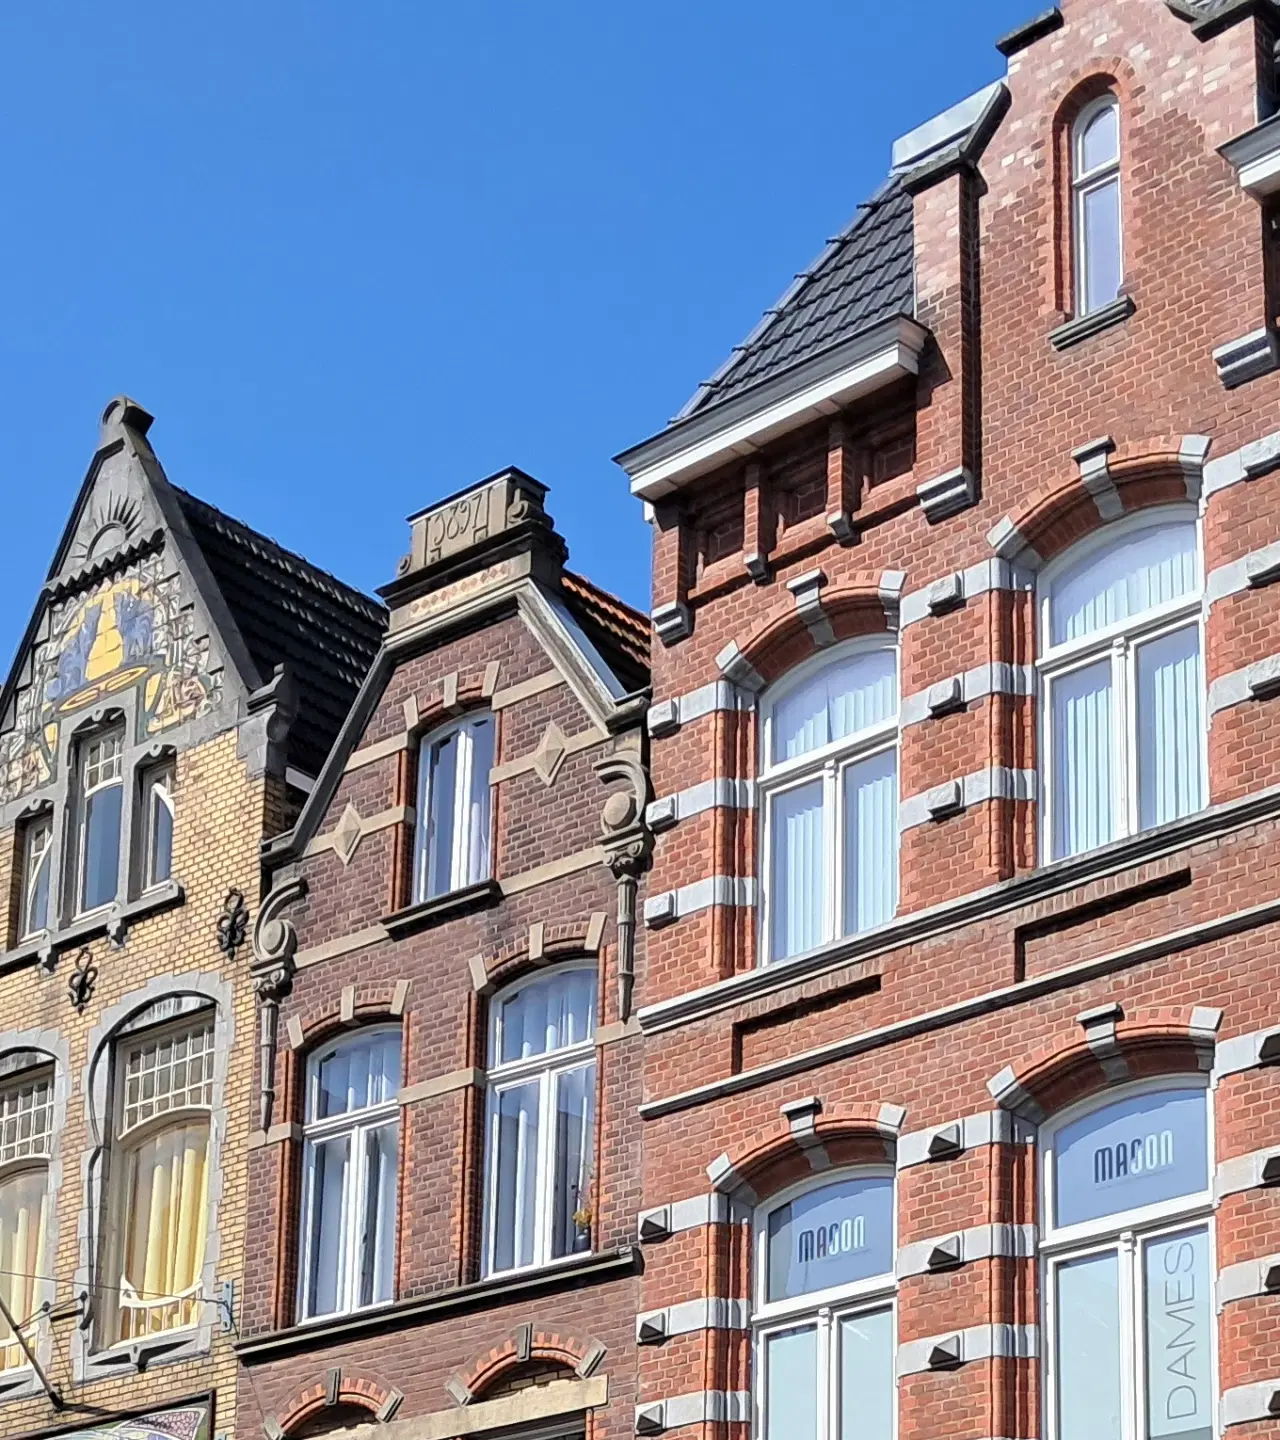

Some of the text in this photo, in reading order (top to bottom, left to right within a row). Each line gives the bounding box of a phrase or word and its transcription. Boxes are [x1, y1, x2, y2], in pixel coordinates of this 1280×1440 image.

[433, 493, 483, 547] 1897
[1094, 1129, 1174, 1184] MASON
[798, 1215, 865, 1263] MASON
[1163, 1239, 1197, 1422] DAMES
